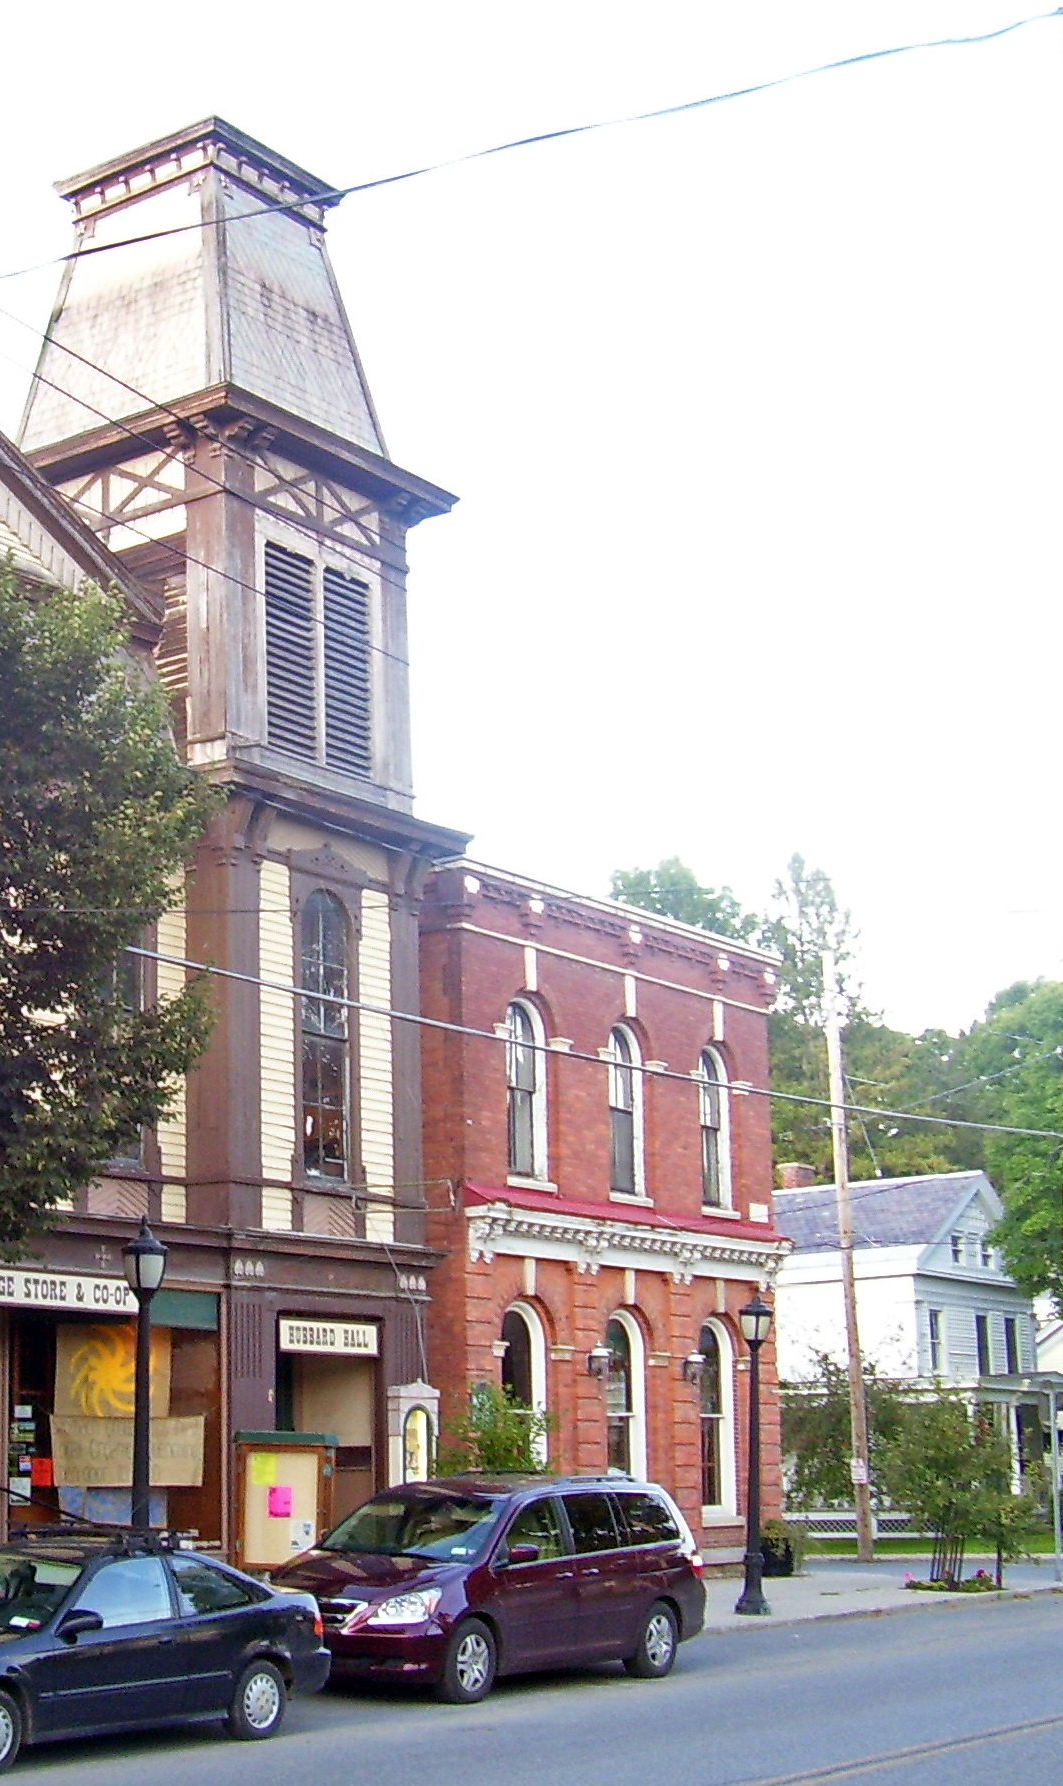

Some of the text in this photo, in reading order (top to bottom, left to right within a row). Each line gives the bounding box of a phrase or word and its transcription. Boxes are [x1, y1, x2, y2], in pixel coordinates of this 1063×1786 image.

[23, 1277, 67, 1302] STORE
[75, 1281, 86, 1303] &
[93, 1283, 131, 1306] CO-OP
[288, 1325, 369, 1348] HUBBARD HALL
